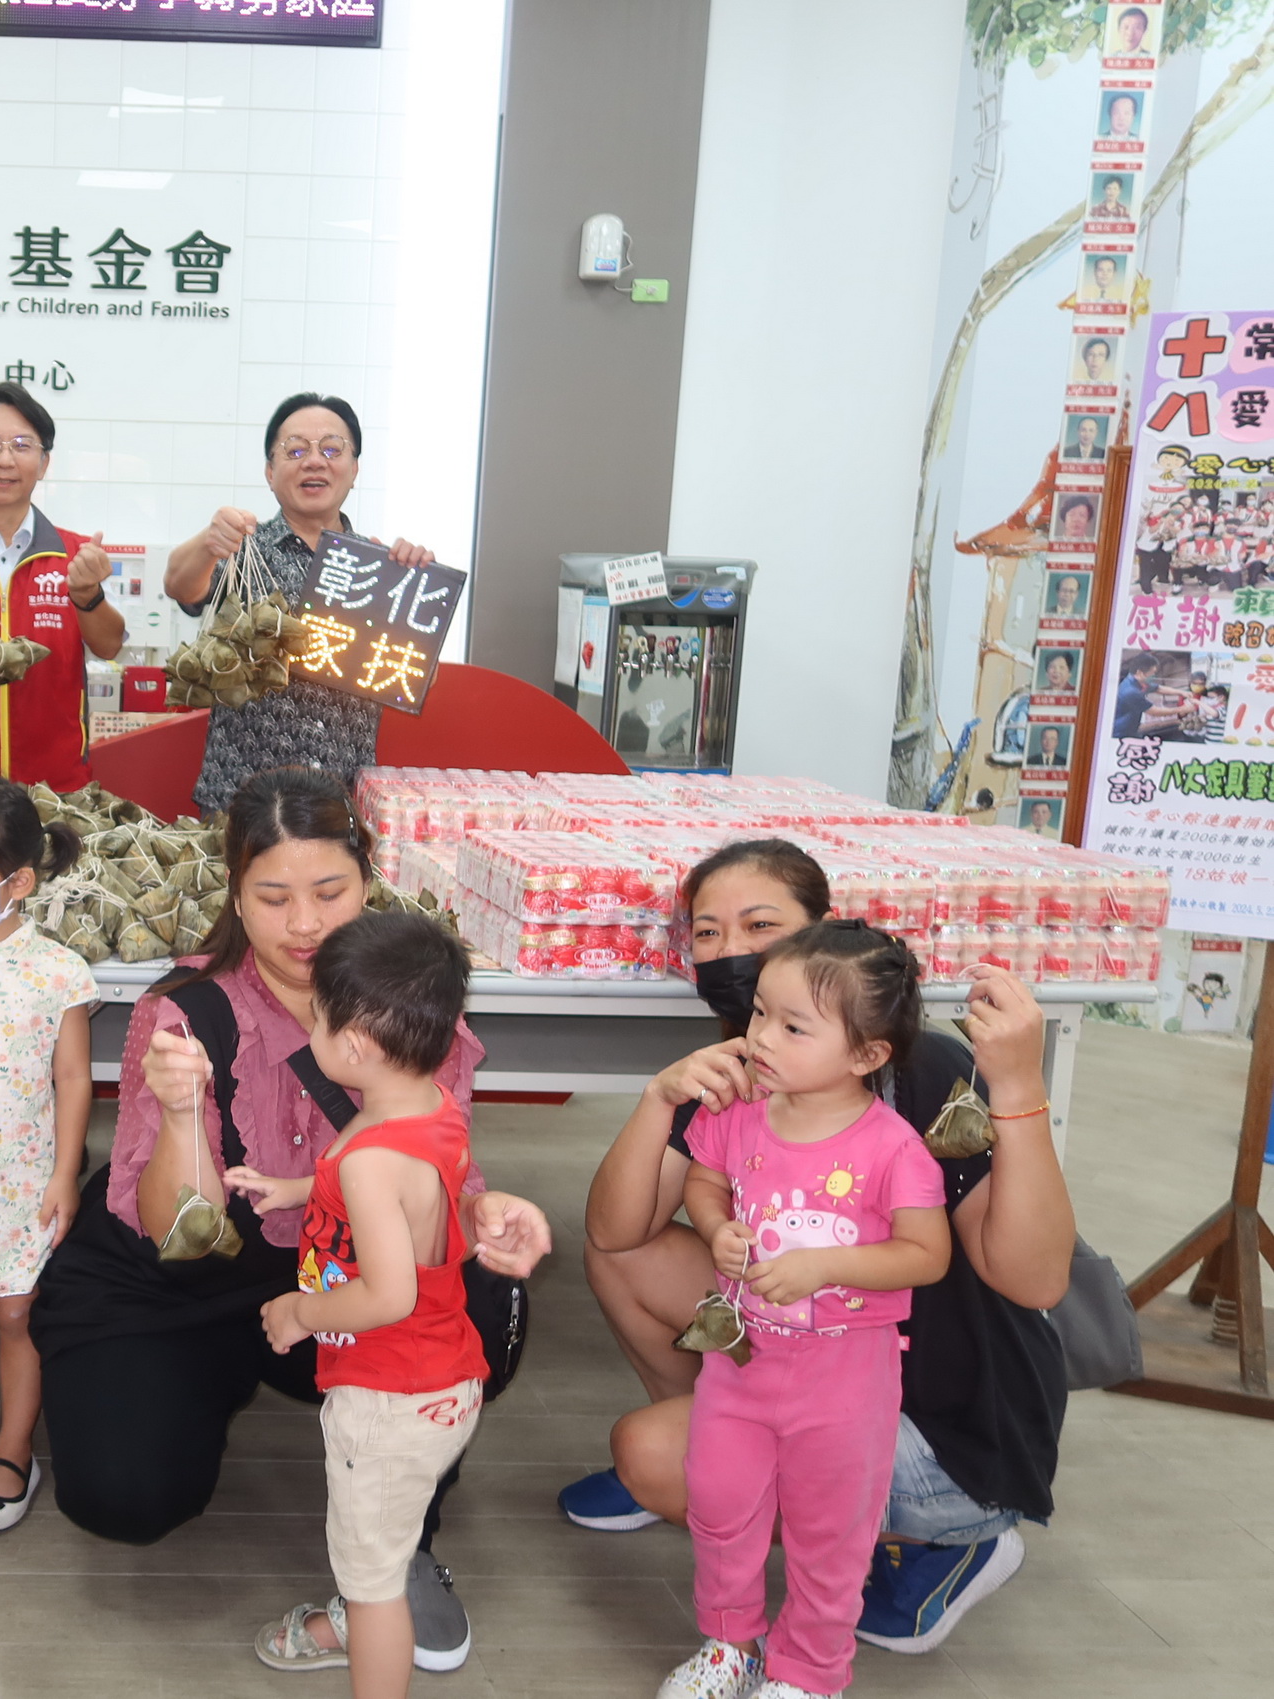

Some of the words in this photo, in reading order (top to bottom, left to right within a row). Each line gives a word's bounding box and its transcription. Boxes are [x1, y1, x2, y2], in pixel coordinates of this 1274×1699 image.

[17, 297, 99, 315] Children
[107, 300, 142, 316] and
[151, 301, 230, 318] Families
[1230, 390, 1269, 428] 愛
[1188, 454, 1274, 476] 愛心
[315, 547, 450, 636] 彰化
[1127, 591, 1221, 651] 感謝
[289, 613, 426, 703] 家扶
[1107, 734, 1164, 804] 感謝
